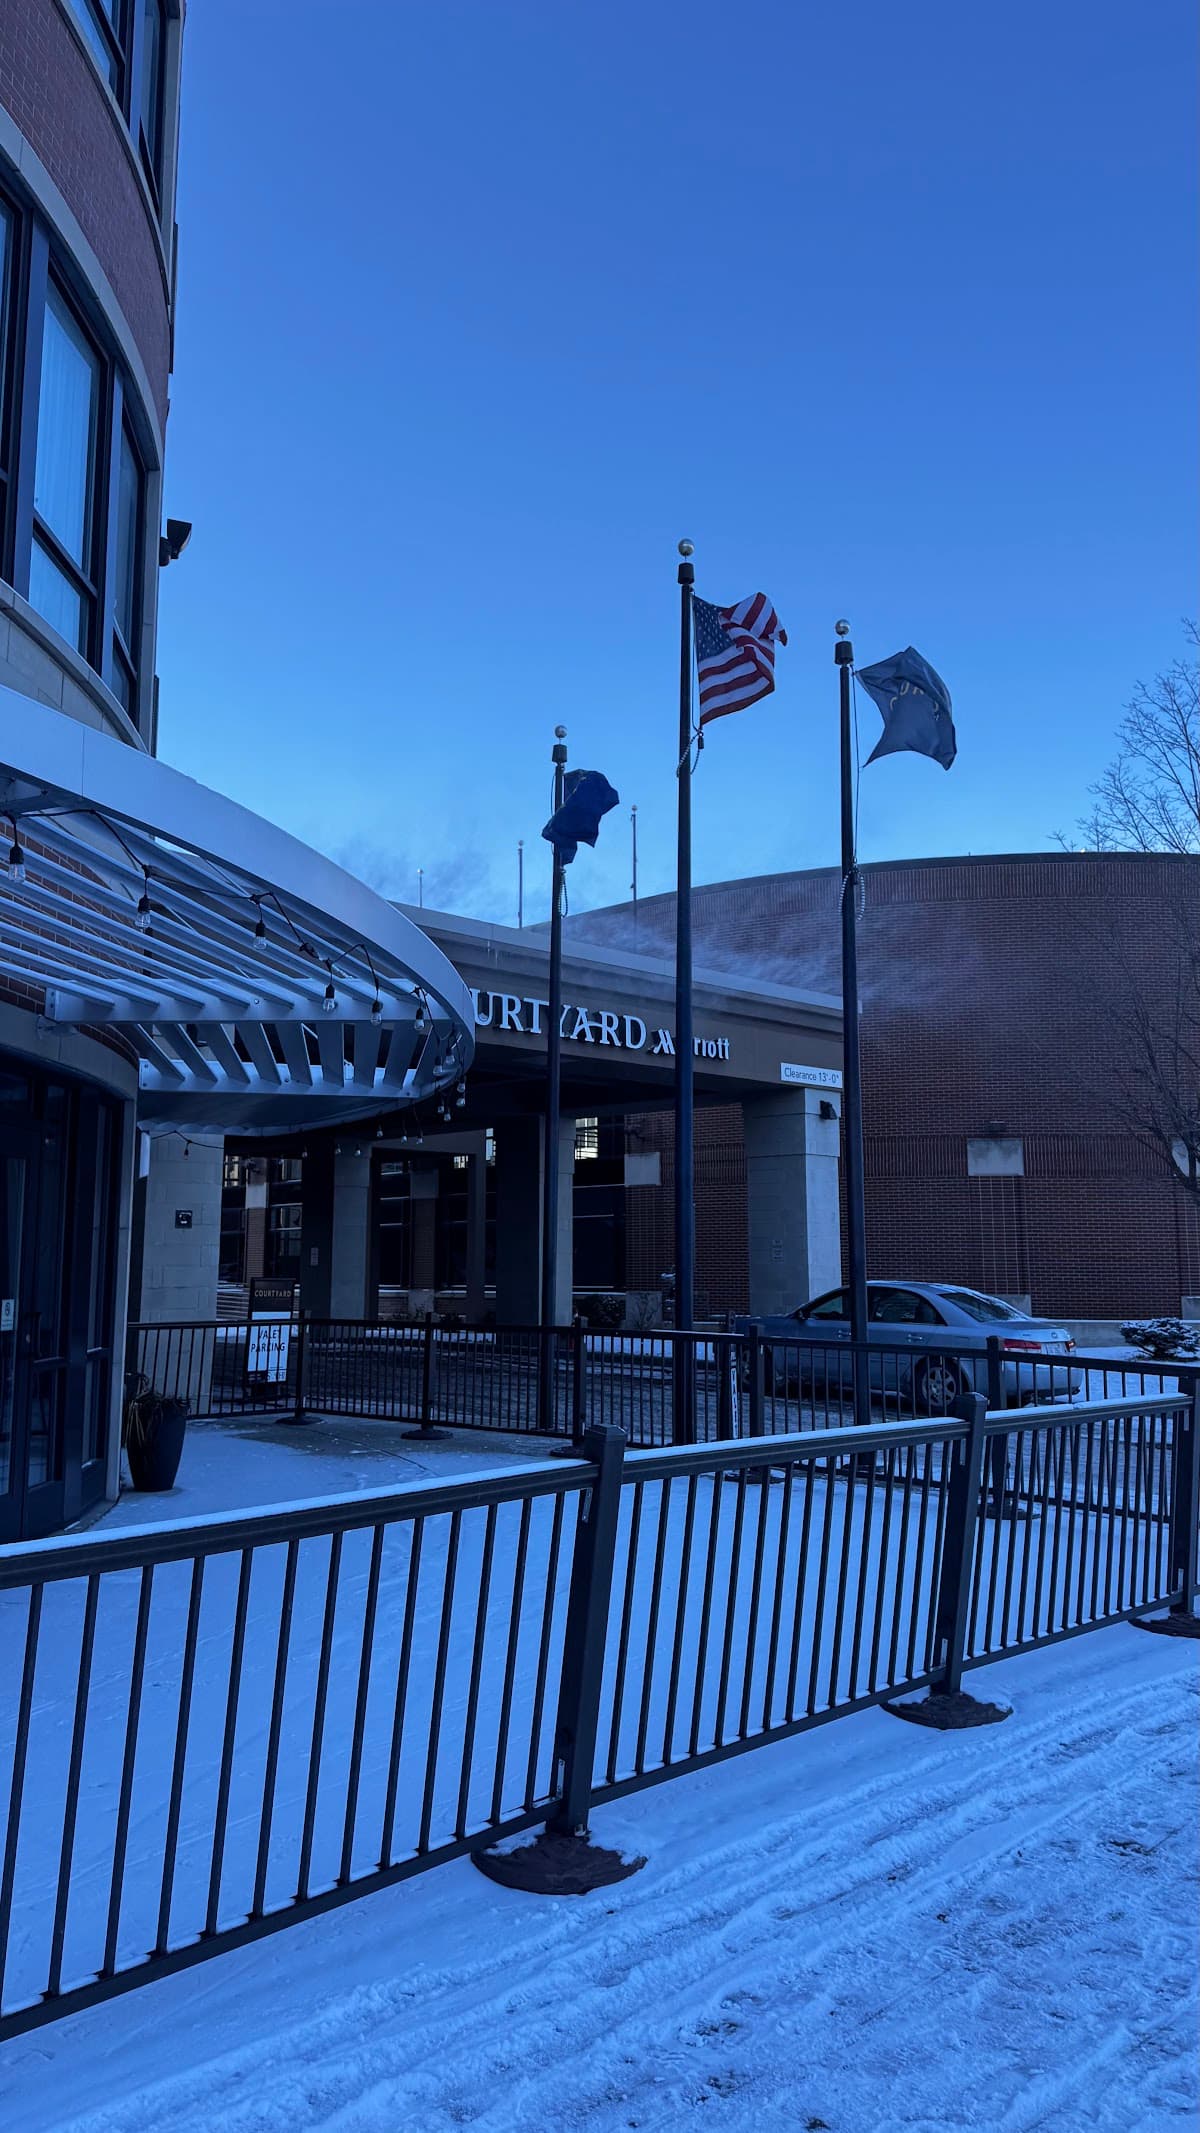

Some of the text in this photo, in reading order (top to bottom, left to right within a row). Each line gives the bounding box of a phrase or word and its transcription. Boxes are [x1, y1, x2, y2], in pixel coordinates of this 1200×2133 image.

[784, 1067, 817, 1081] Clearance
[254, 1289, 292, 1297] COURTYARD
[257, 1329, 281, 1340] VAE
